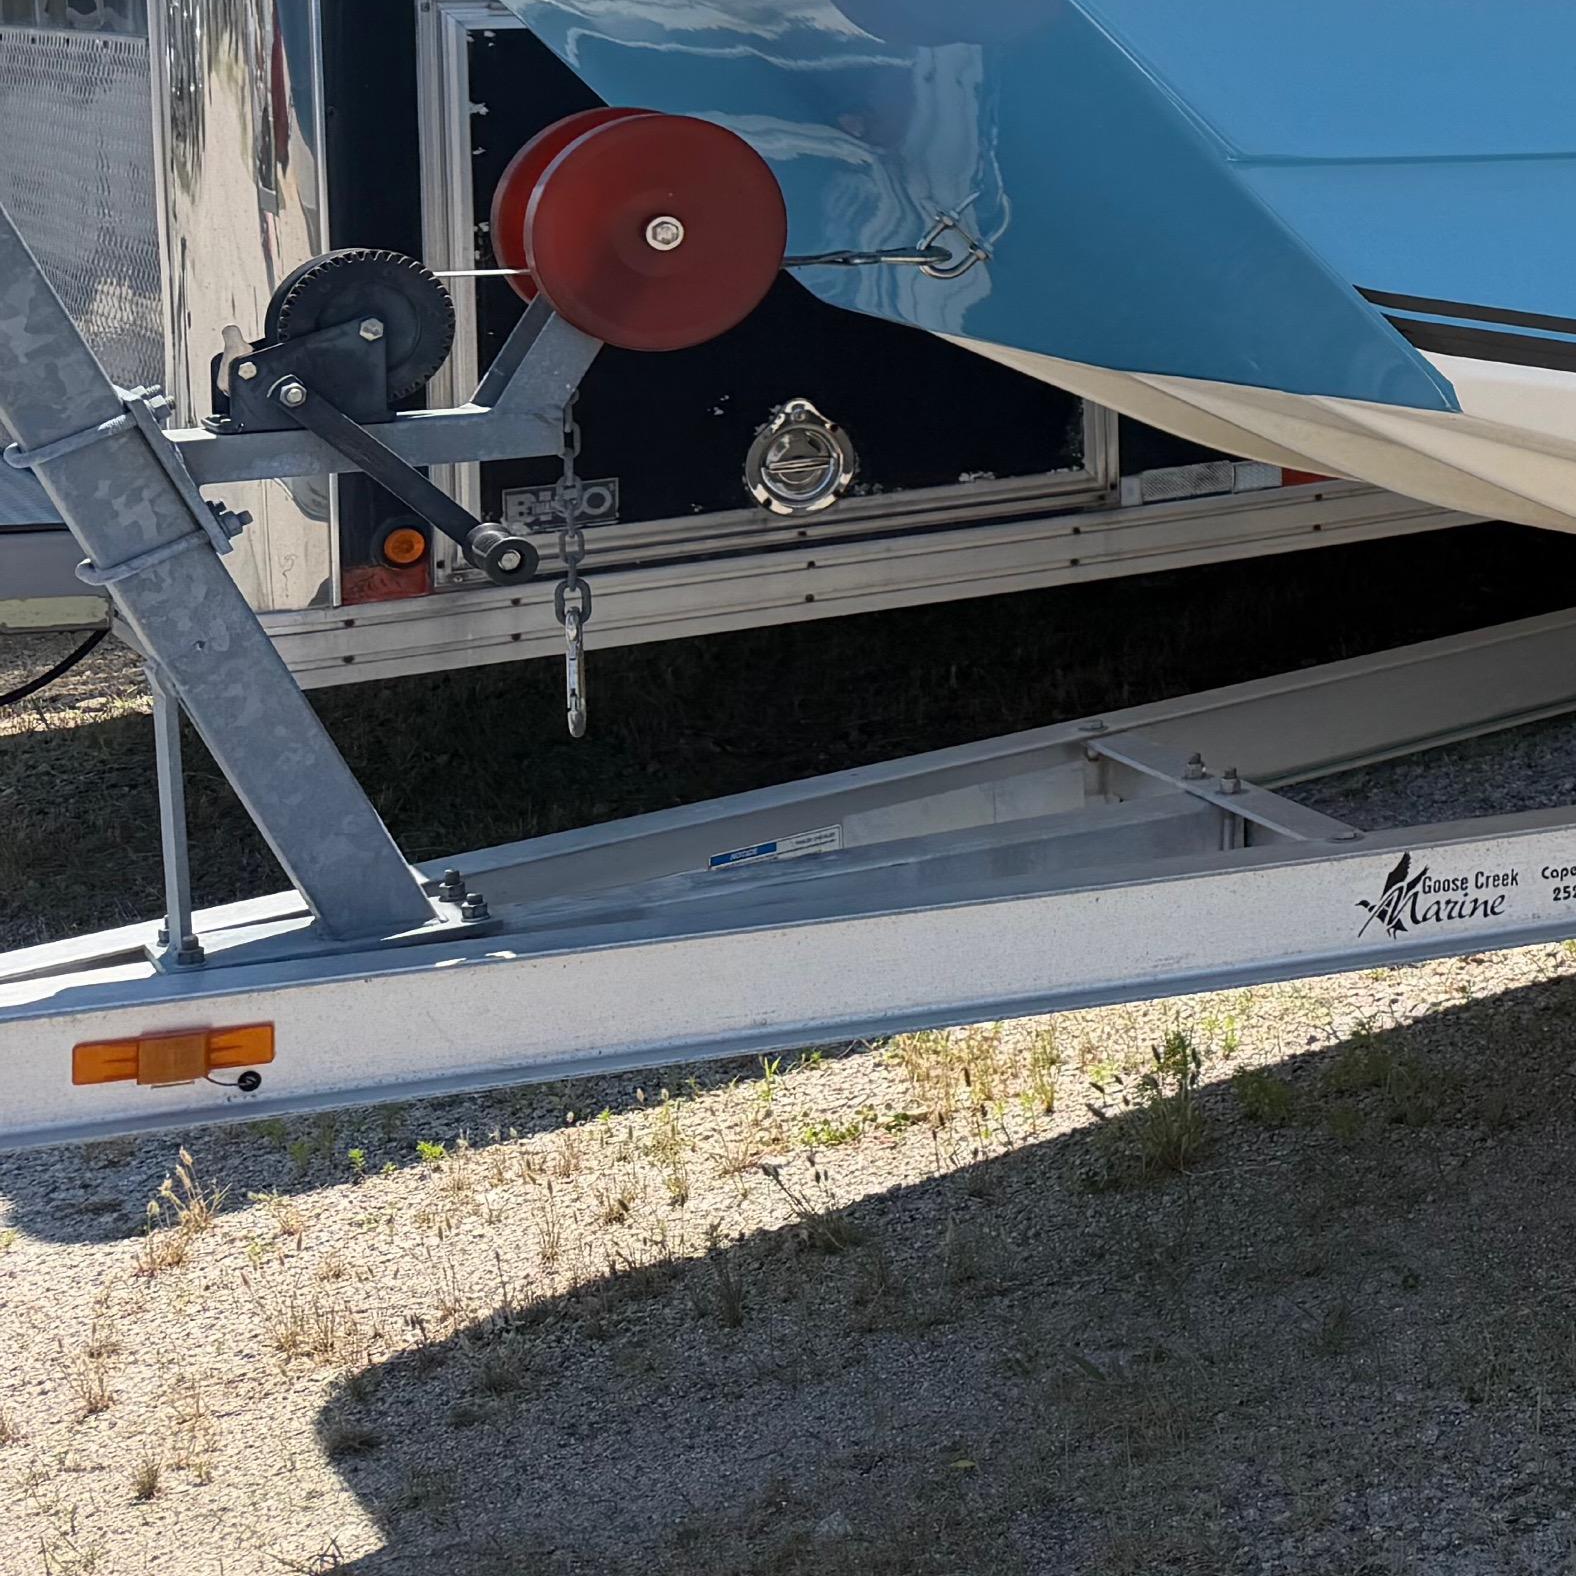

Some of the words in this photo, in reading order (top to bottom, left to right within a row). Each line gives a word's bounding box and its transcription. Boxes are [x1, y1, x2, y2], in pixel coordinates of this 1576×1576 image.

[1422, 876, 1468, 894] Goose
[1475, 868, 1519, 890] Creek
[1358, 884, 1506, 938] Marine
